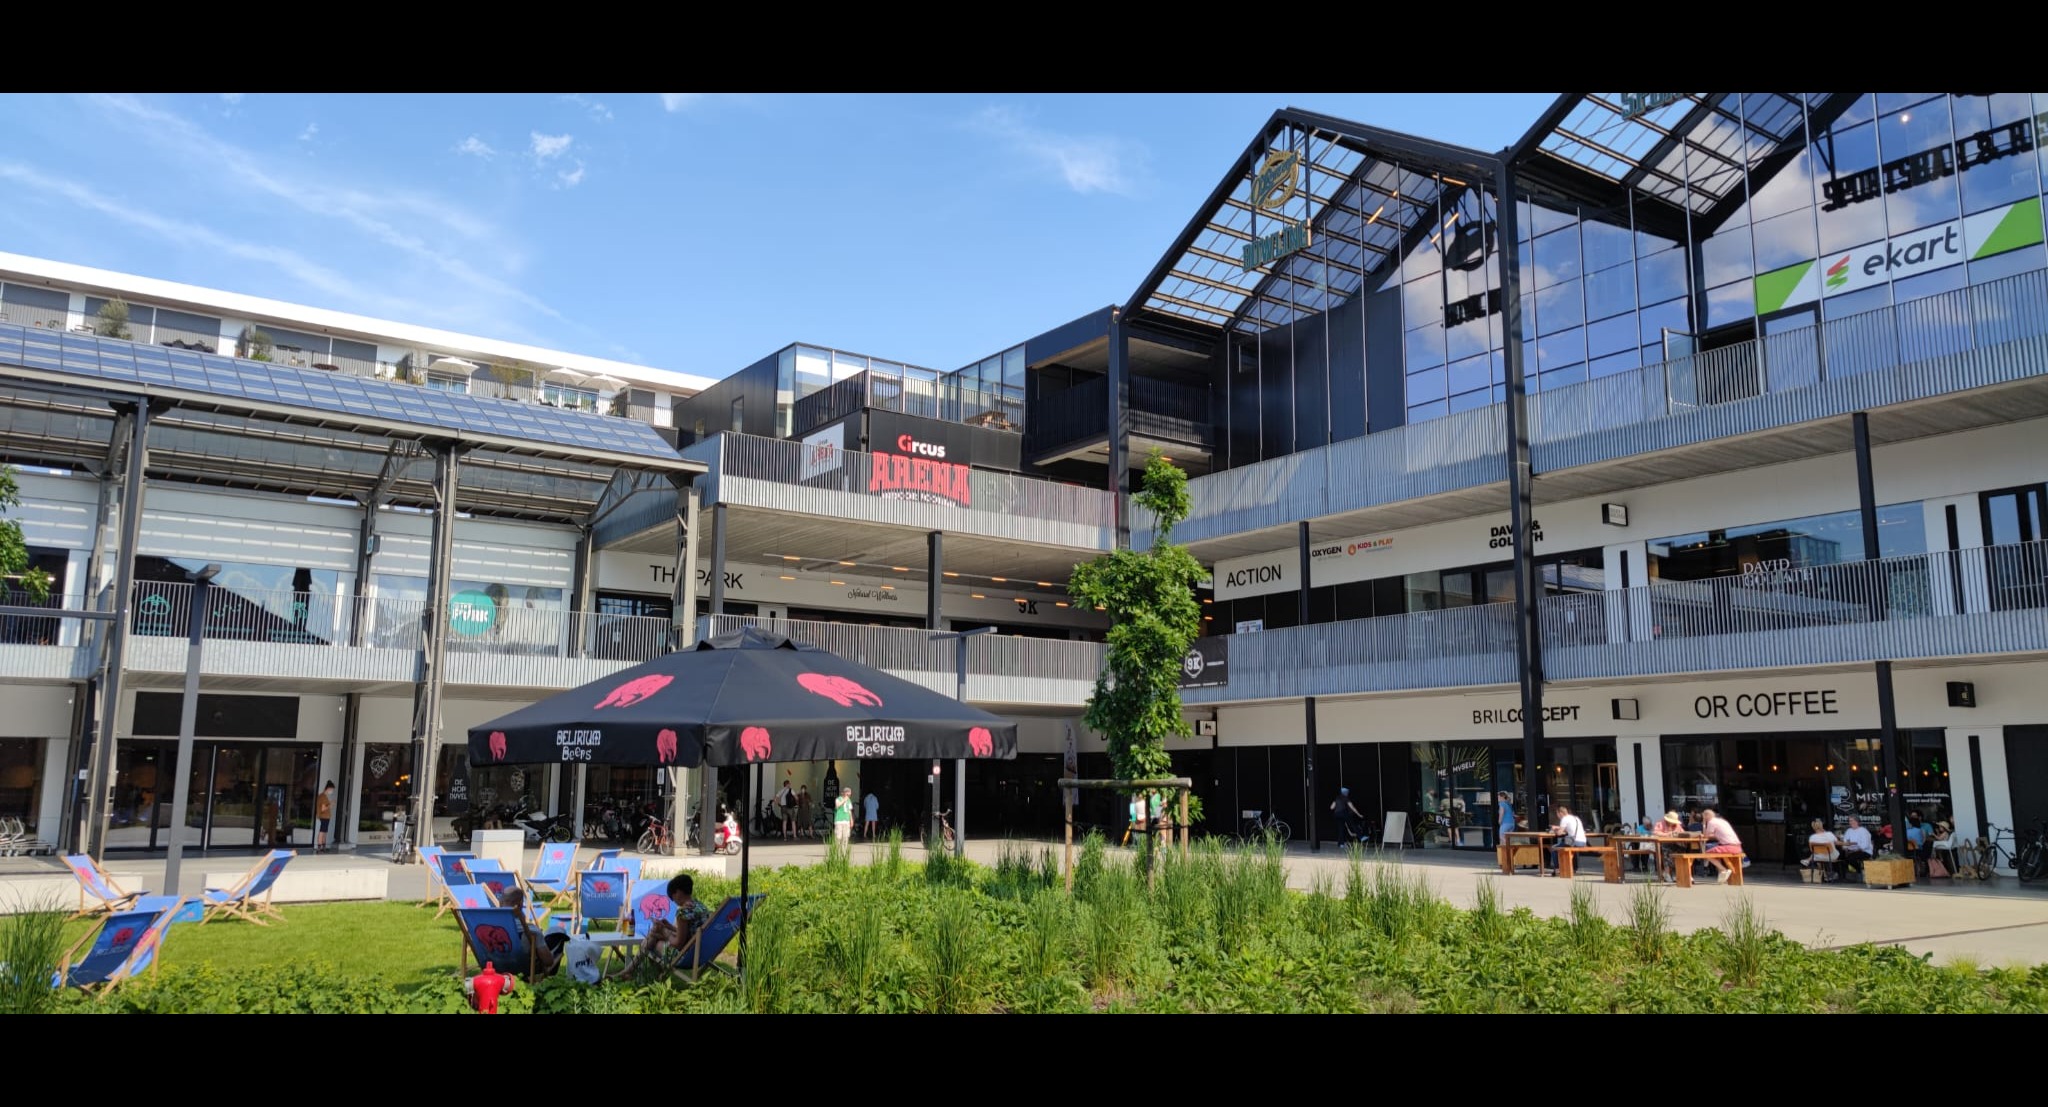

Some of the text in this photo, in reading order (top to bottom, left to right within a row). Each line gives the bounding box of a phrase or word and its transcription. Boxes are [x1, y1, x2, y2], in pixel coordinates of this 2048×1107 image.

[1242, 218, 1311, 272] BOWLING
[1863, 226, 1958, 276] ekart
[897, 434, 946, 458] Circus
[869, 451, 970, 508] ARENA
[1531, 520, 1541, 531] &
[1357, 541, 1372, 549] KIDS
[1378, 537, 1393, 546] PLAY
[1489, 531, 1544, 549] GOLH
[1312, 546, 1342, 557] OXYGEN
[650, 565, 676, 583] TH
[1743, 558, 1790, 574] DAVID
[1226, 564, 1282, 588] ACTION
[1018, 600, 1038, 615] 9K
[1187, 656, 1200, 671] 9K
[1694, 690, 1839, 719] OR COFFEE
[1473, 705, 1581, 724] BRILCCEPT
[556, 729, 601, 746] DELIRIUM
[846, 725, 905, 742] DELIRIUM
[562, 745, 592, 761] Beers
[856, 741, 895, 757] Beers
[1452, 761, 1476, 773] MYSELF
[1856, 793, 1885, 802] MIST
[1435, 815, 1451, 827] EYE
